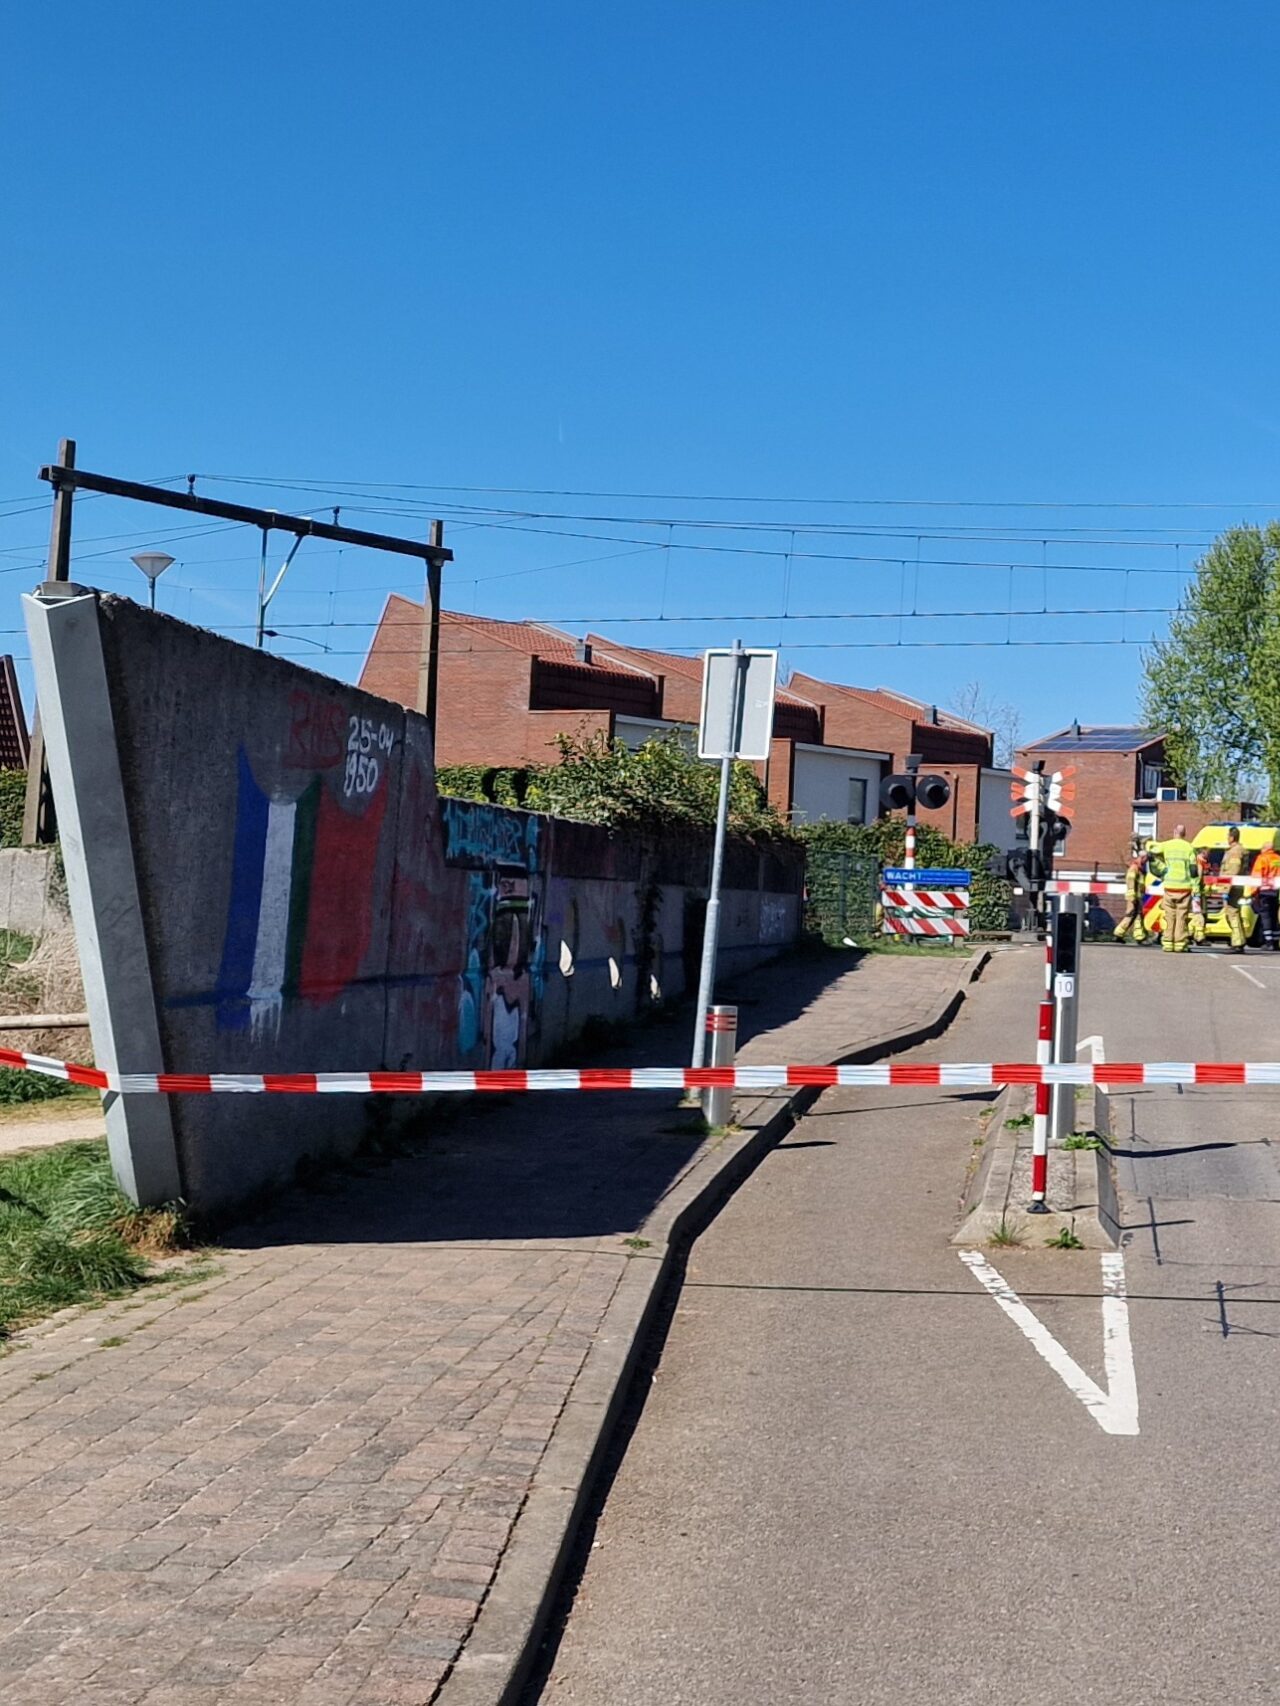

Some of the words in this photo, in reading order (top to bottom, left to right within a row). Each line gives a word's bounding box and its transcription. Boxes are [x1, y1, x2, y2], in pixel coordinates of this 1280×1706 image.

[347, 716, 394, 758] 25-04
[343, 752, 378, 797] 1950
[886, 871, 922, 880] WACHT
[1057, 981, 1073, 993] 10
